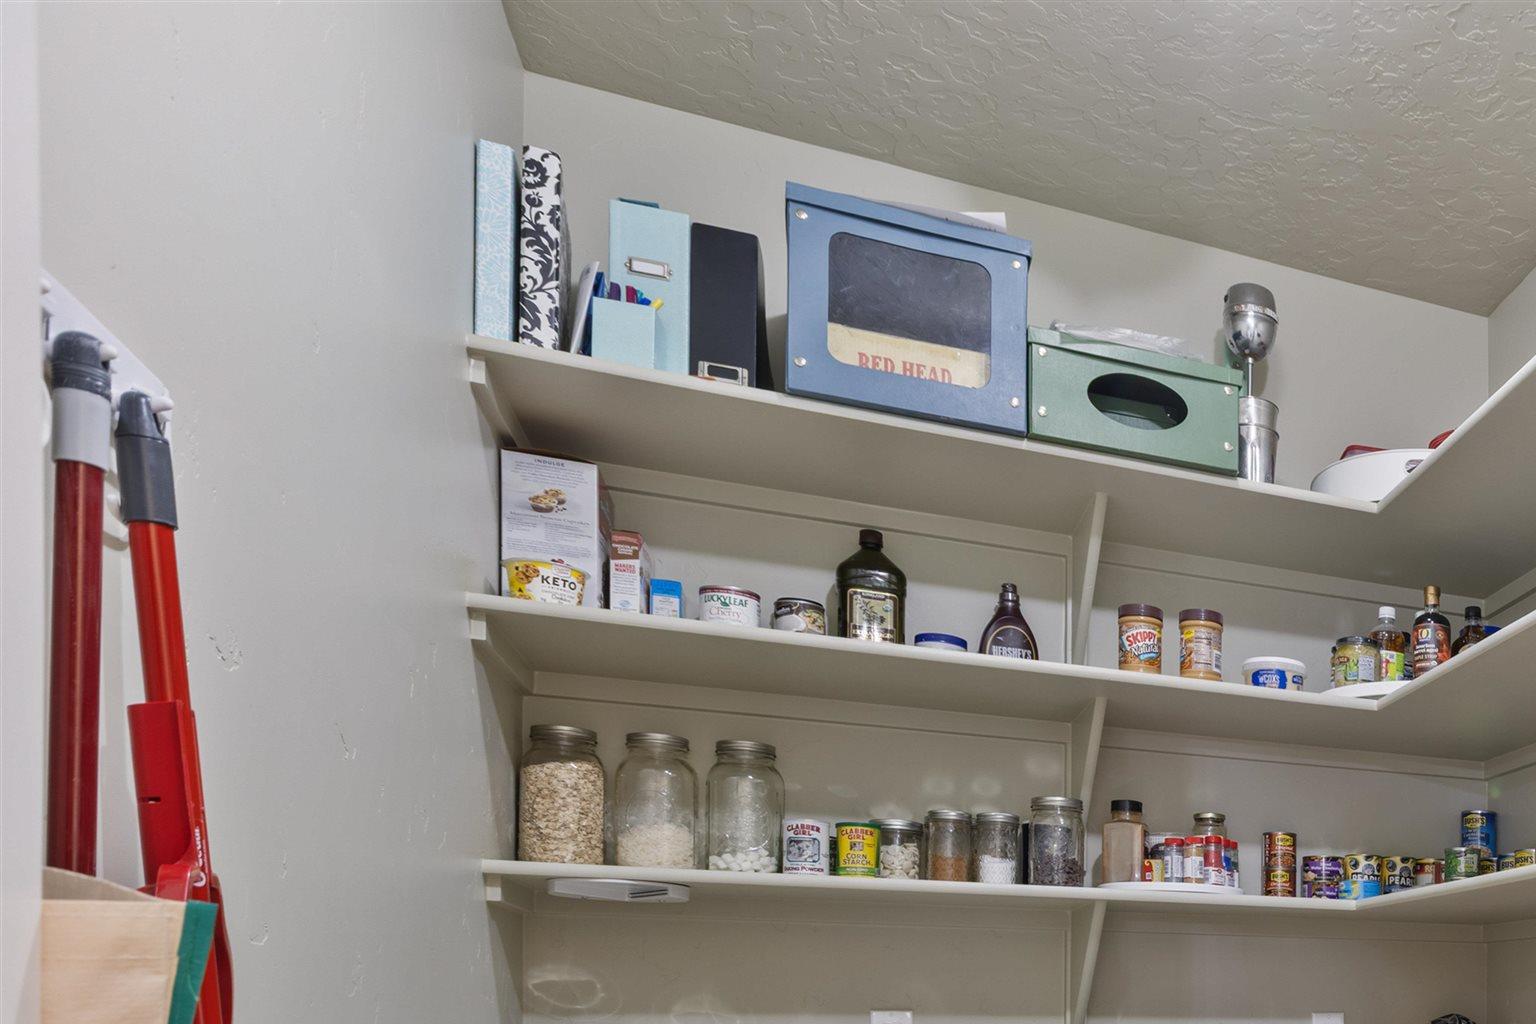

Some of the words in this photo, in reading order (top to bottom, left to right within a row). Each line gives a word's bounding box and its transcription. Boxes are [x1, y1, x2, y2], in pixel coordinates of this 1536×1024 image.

[857, 352, 896, 373] RED
[902, 361, 953, 384] HEAD
[541, 574, 577, 591] KETO
[704, 594, 728, 606] LUCKY
[727, 599, 749, 608] LEAF
[708, 606, 743, 620] Cherry
[1126, 629, 1158, 645] SKIPPY
[786, 823, 821, 834] CLABBER
[792, 829, 813, 837] GIRL
[840, 827, 875, 837] CLABBER
[845, 852, 868, 861] CORN
[842, 859, 871, 867] STARCH
[800, 866, 825, 874] POWDER
